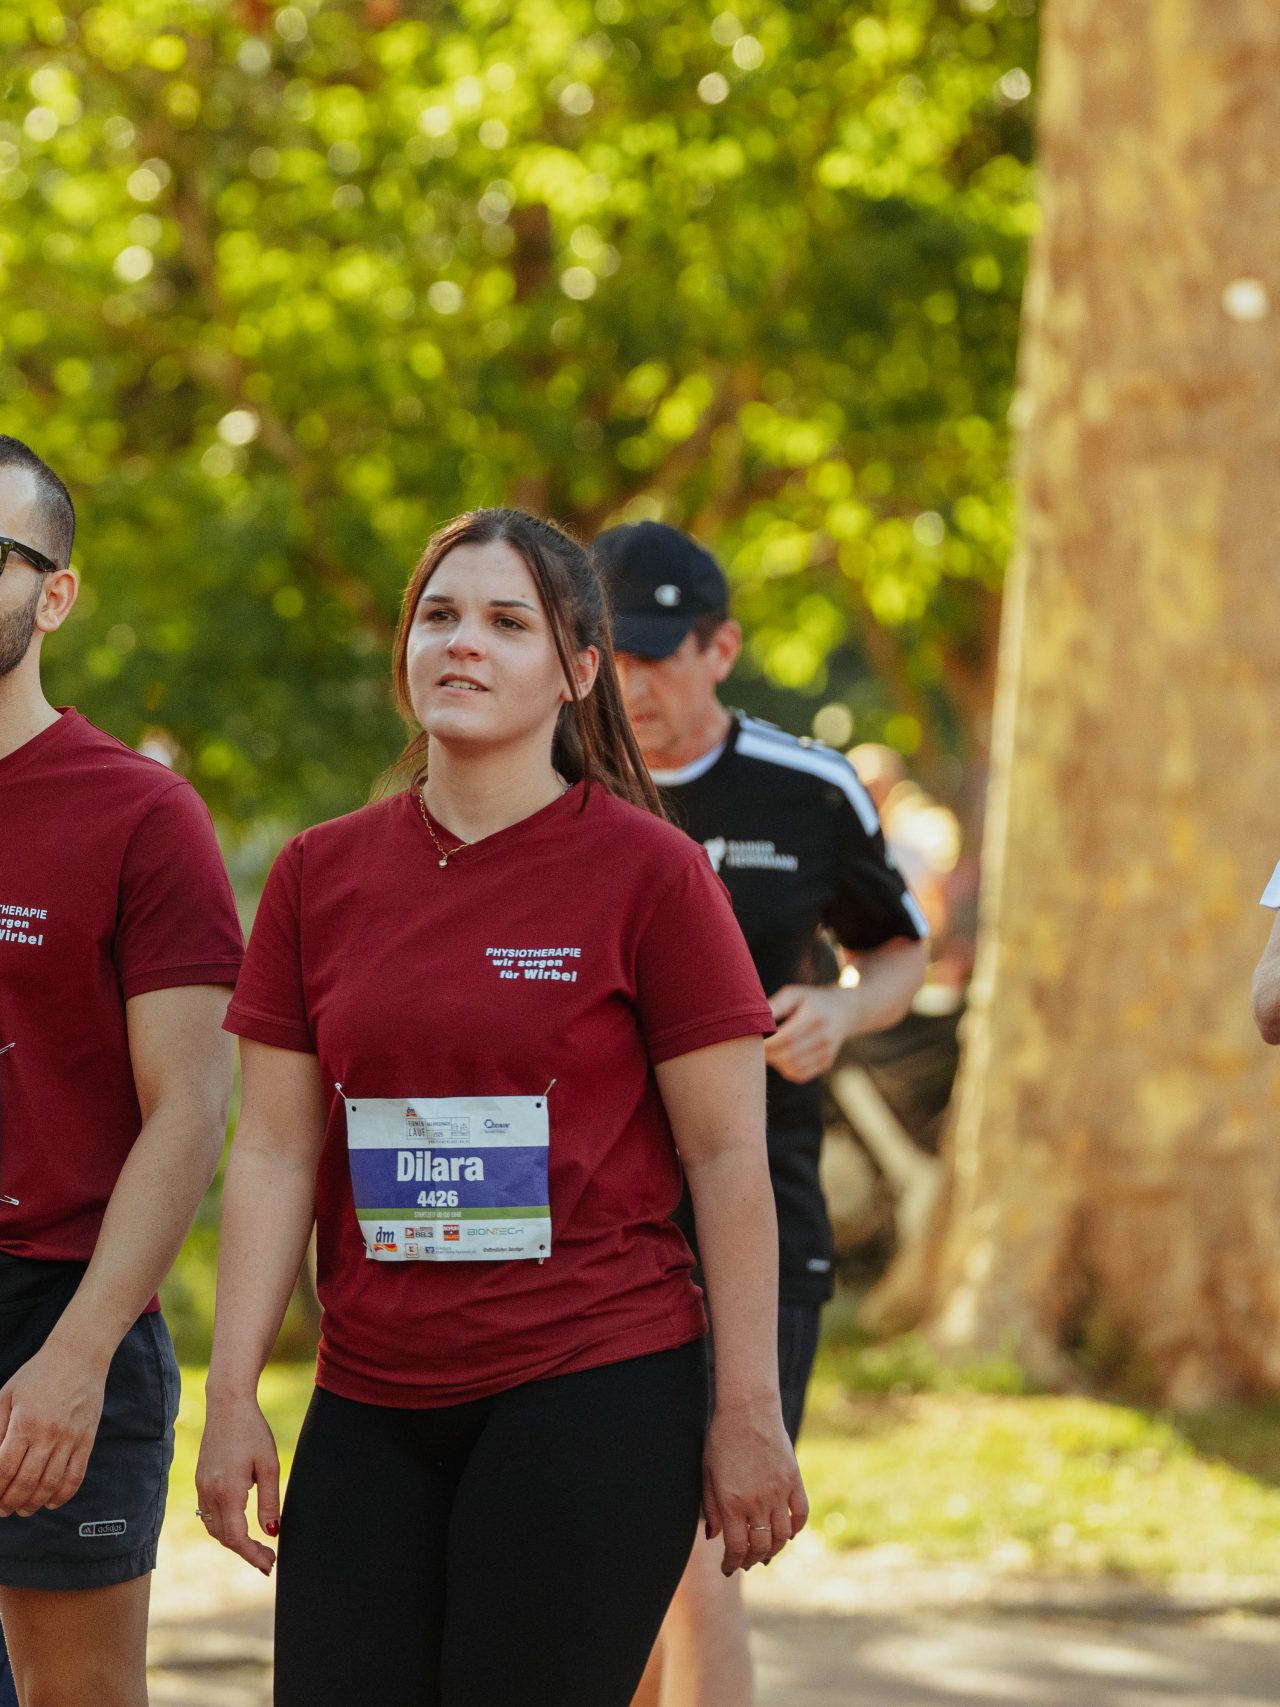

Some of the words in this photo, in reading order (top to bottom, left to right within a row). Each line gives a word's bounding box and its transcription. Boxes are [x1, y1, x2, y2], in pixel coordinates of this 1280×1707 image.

[485, 947, 582, 957] PHYSIOTHERAPIE
[492, 958, 514, 967] wir
[517, 959, 564, 969] sorgen
[499, 970, 520, 979] für
[524, 969, 578, 983] Wirbel
[396, 1150, 485, 1182] Dilara
[417, 1190, 459, 1207] 4426
[375, 1226, 395, 1243] dm
[467, 1227, 524, 1236] BIONTECH
